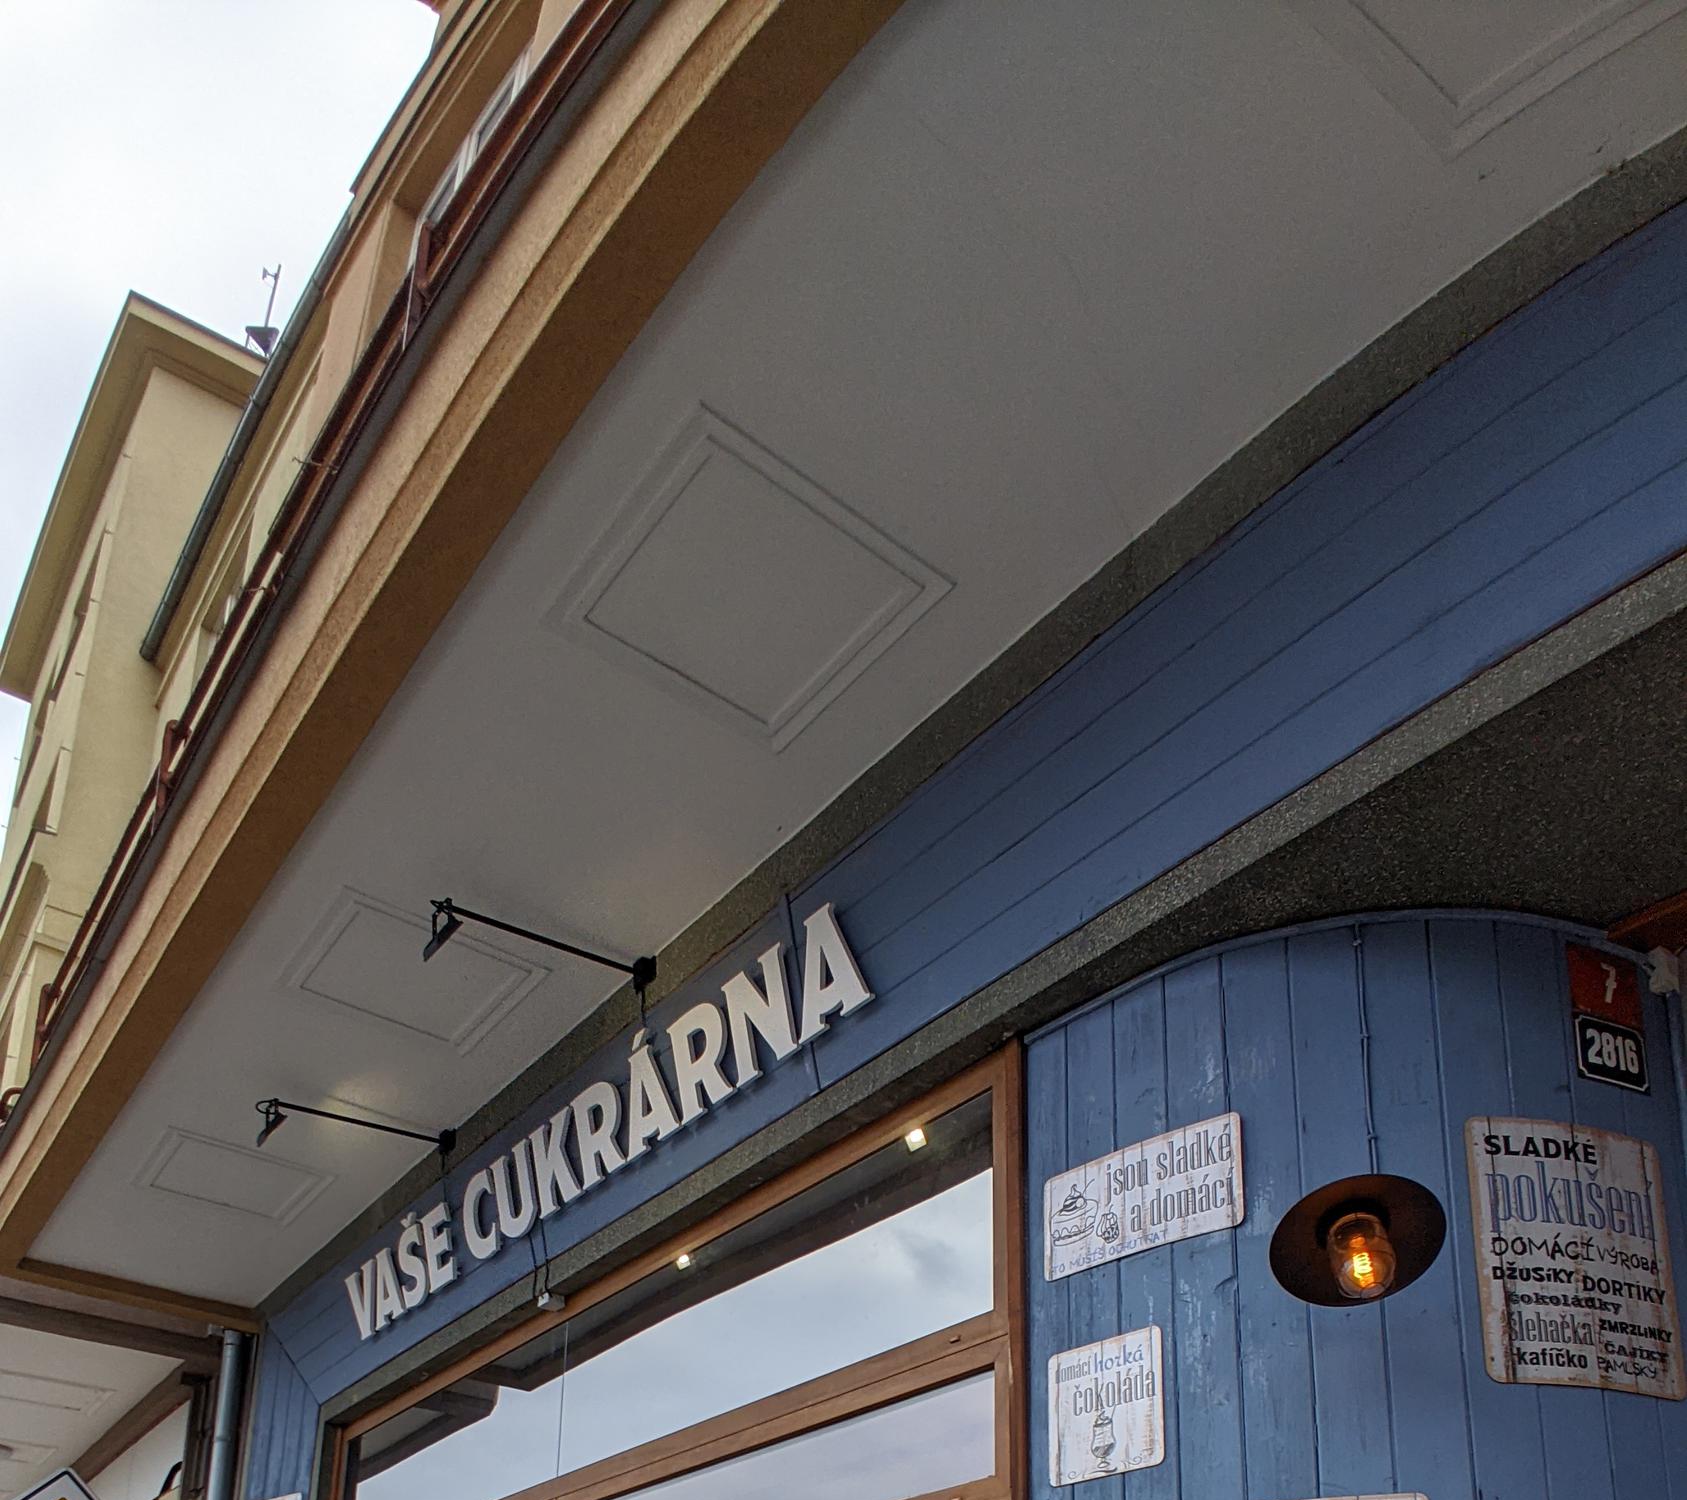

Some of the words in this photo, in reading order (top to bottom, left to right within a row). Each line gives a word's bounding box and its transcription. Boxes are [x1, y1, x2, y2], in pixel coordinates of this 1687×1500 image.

[1600, 962, 1617, 1003] 7
[1586, 1028, 1639, 1074] 2816
[344, 1202, 459, 1340] VAŠE
[463, 902, 875, 1260] CUKRÁRNA
[1106, 1158, 1149, 1204] jsou
[1156, 1123, 1232, 1180] sladké
[1484, 1134, 1597, 1165] SLADKÉ
[1131, 1203, 1142, 1232] a
[1150, 1167, 1234, 1227] domácí
[1485, 1161, 1656, 1242] pokušení
[1491, 1232, 1594, 1261] DOMÁCÍ
[1597, 1244, 1660, 1276] VÝROBA
[1583, 1275, 1666, 1306] DORTÍKY
[1510, 1310, 1595, 1346] šlehačka
[1517, 1347, 1588, 1369] kafíčko
[1073, 1365, 1156, 1416] čokoláda
